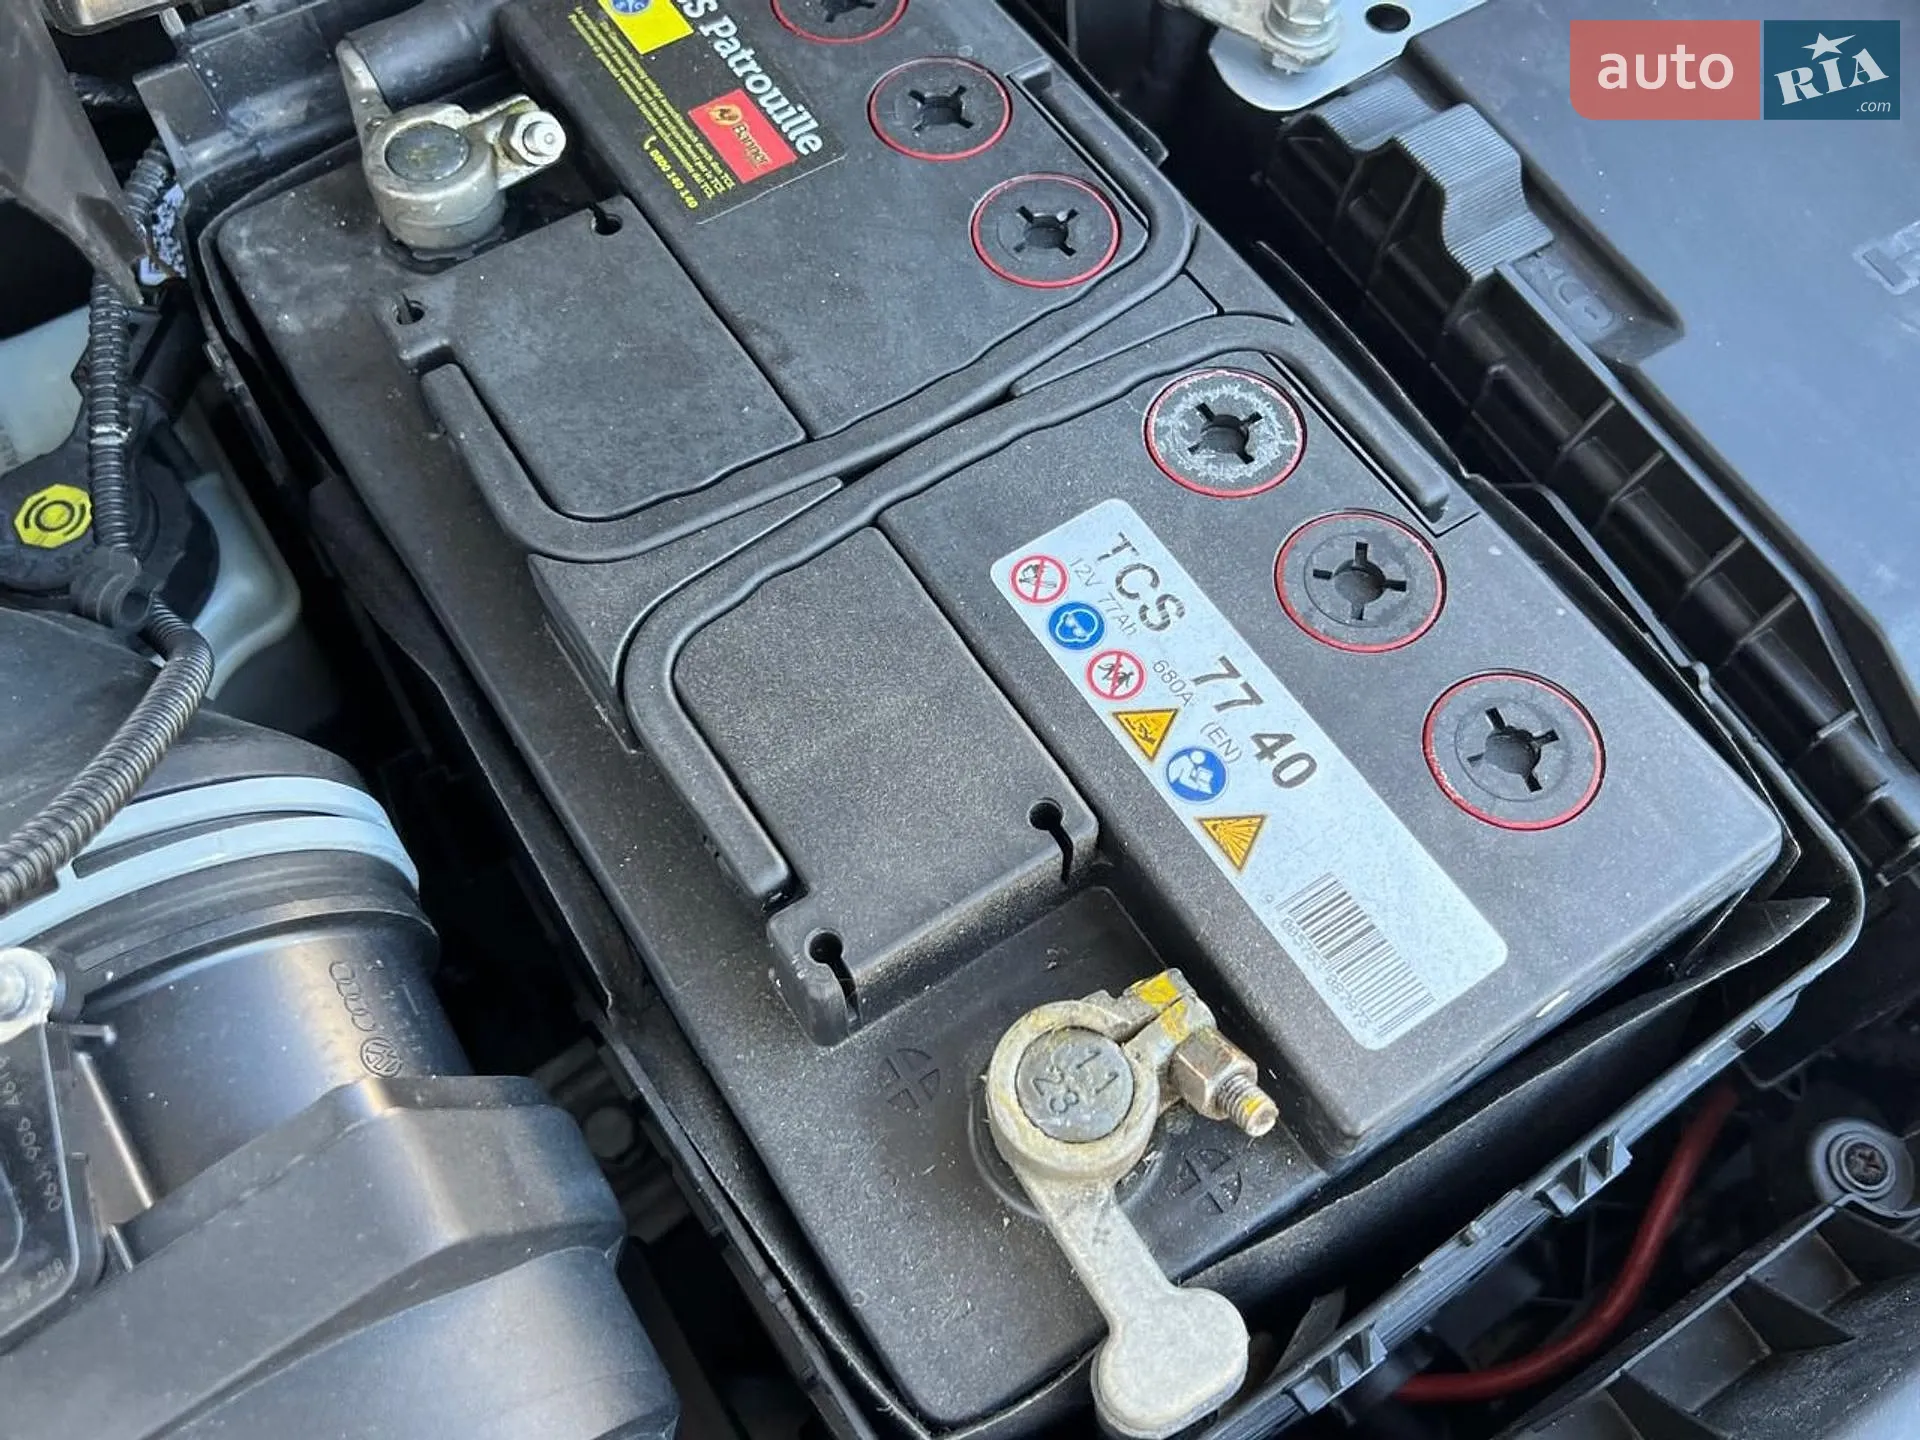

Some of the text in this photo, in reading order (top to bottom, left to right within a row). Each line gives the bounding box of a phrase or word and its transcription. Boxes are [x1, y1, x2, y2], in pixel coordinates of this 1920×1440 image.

[699, 15, 824, 157] Patrouille
[731, 122, 772, 166] Banner
[1069, 556, 1243, 765] 12V 77Ah 680A (EN)
[1097, 532, 1318, 789] TCS 77 40
